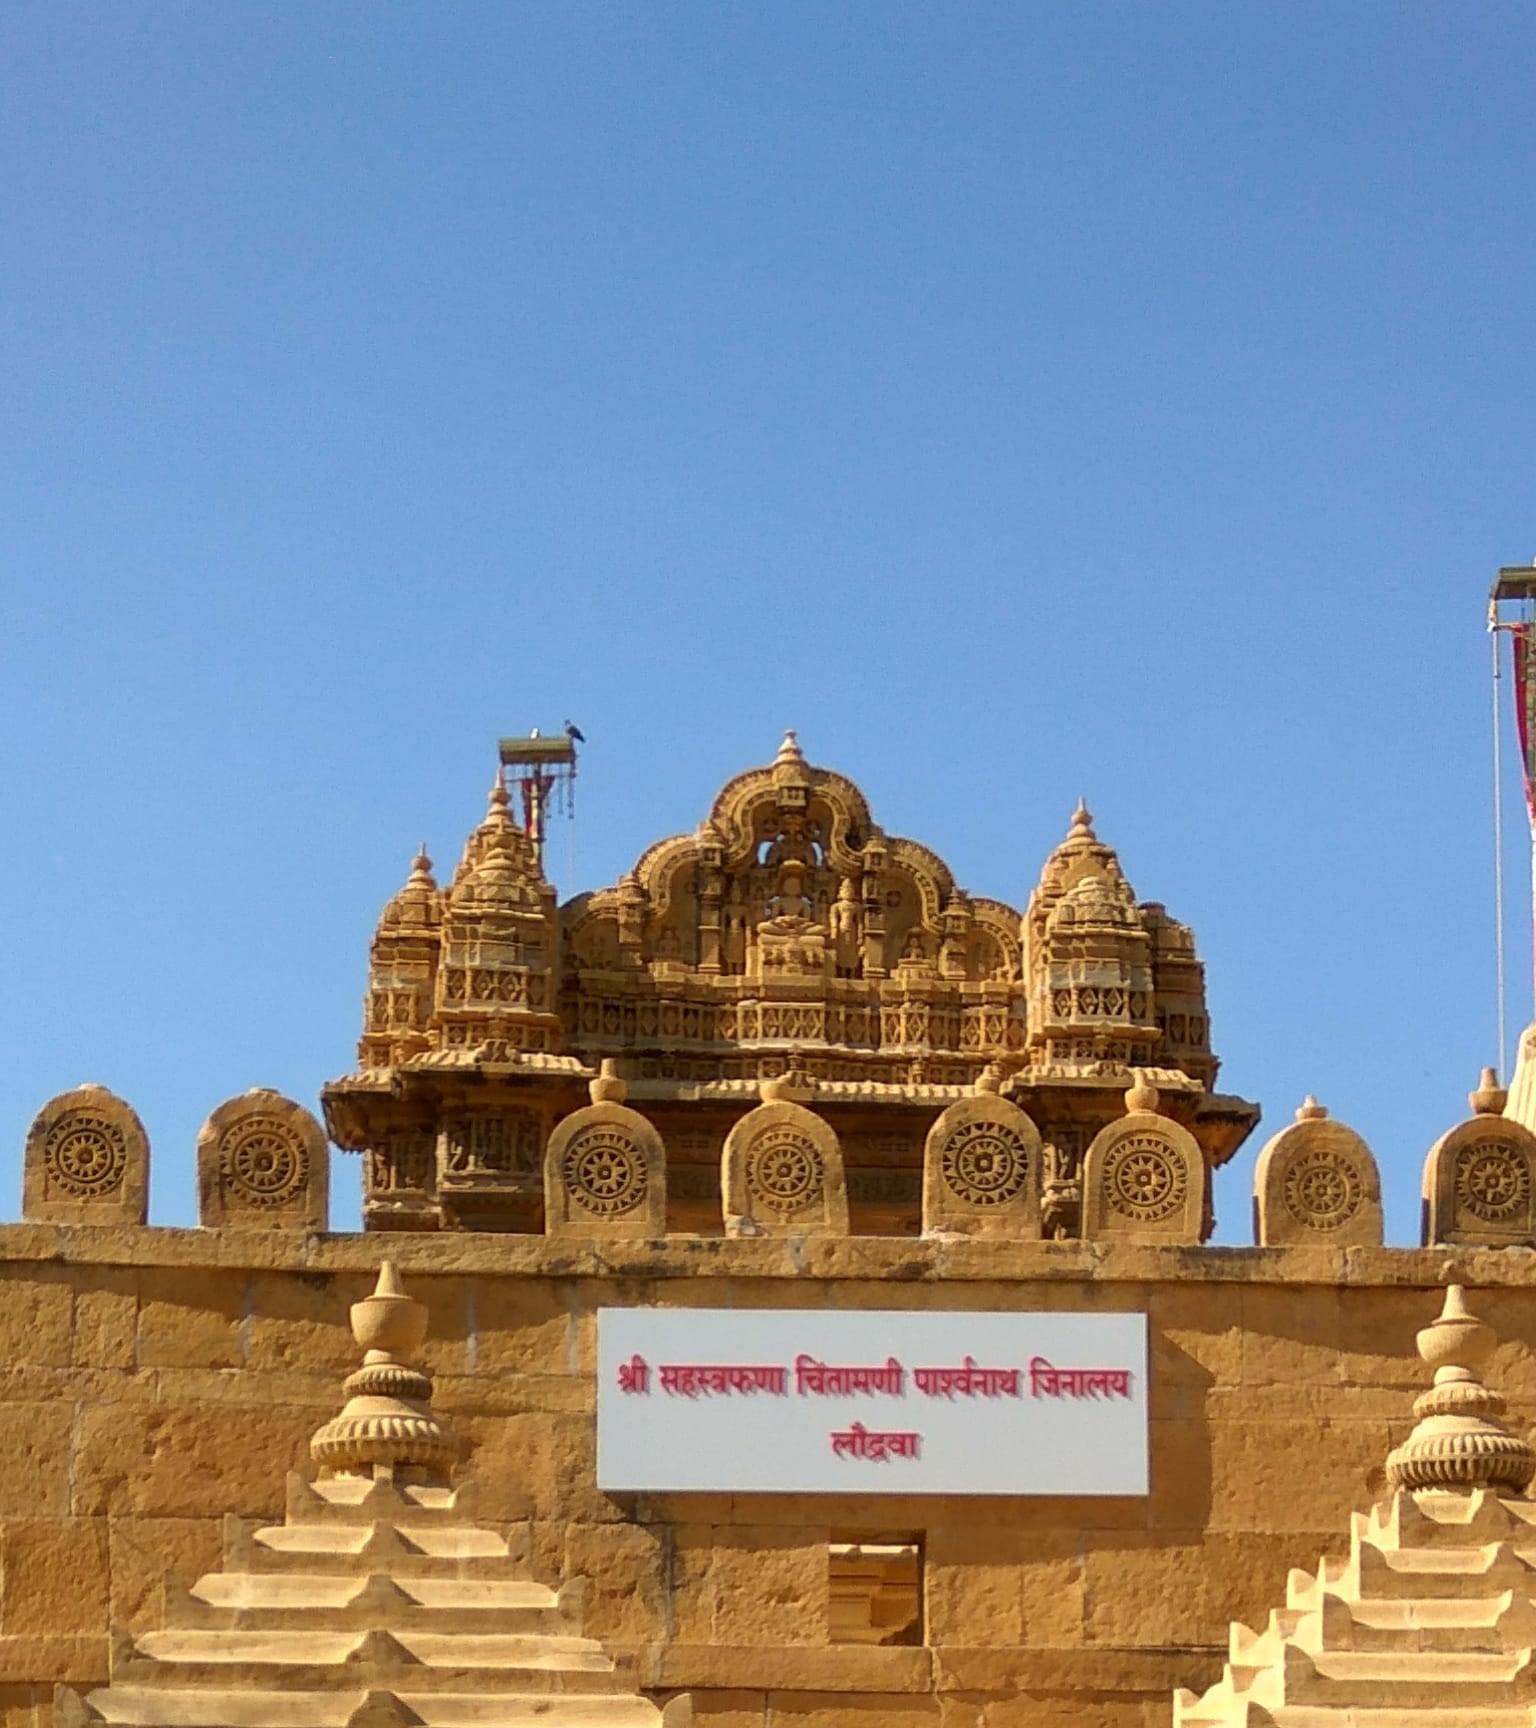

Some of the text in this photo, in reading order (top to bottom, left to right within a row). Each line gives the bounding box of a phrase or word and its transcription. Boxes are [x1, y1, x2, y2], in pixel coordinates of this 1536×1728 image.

[617, 1353, 649, 1394] श्री
[796, 1353, 903, 1395] चिंतामणी
[1030, 1356, 1132, 1397] जिनालय
